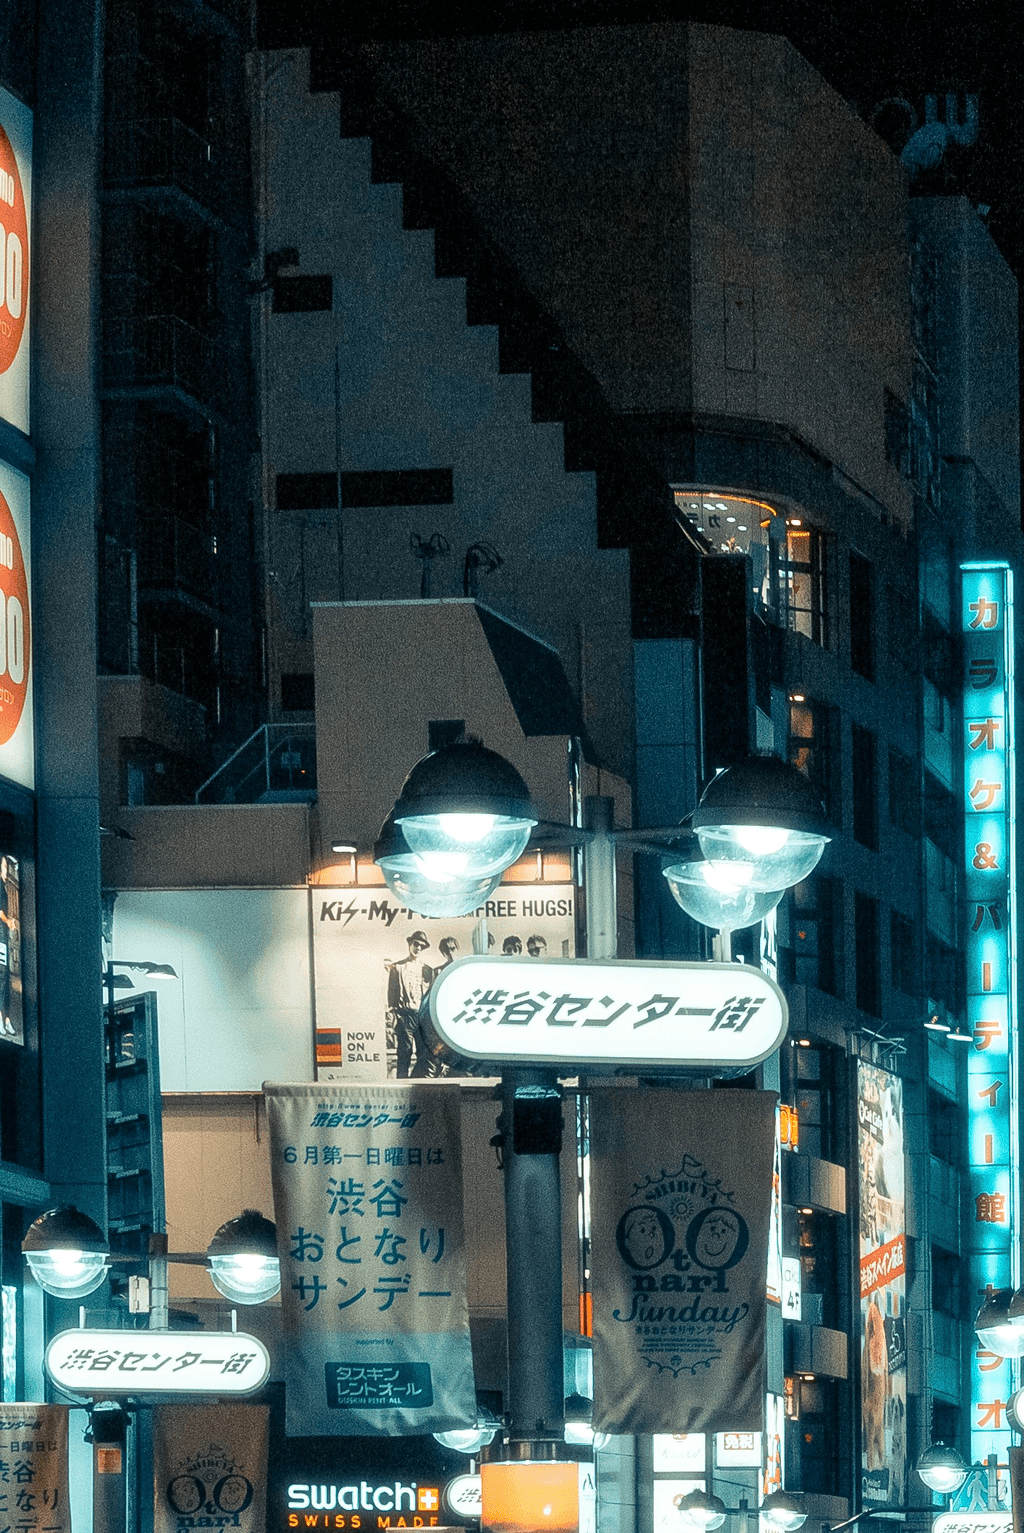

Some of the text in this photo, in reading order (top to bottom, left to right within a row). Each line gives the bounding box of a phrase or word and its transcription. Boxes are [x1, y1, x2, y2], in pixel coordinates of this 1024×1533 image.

[522, 899, 573, 917] HUGS!
[968, 597, 1006, 1226] カラオケ&パーティー館
[452, 988, 767, 1033] 渋谷センター街
[347, 1032, 376, 1041] NOW
[347, 1042, 365, 1051] ON
[347, 1053, 381, 1062] SALE
[310, 1112, 421, 1129] 渋谷センター街
[284, 1145, 445, 1167] 6月第一日曜日は
[326, 1176, 409, 1219] 渋谷
[289, 1225, 446, 1266] おとなり
[631, 1269, 730, 1293] nari
[291, 1273, 452, 1312] サンデー
[612, 1292, 751, 1334] Sunday
[59, 1348, 258, 1375] 渋谷センター街
[337, 1382, 422, 1396] レントオール
[725, 1433, 754, 1449] 免税
[287, 1481, 418, 1512] swatch
[177, 1511, 242, 1528] nari
[288, 1514, 439, 1529] SWISS MADE
